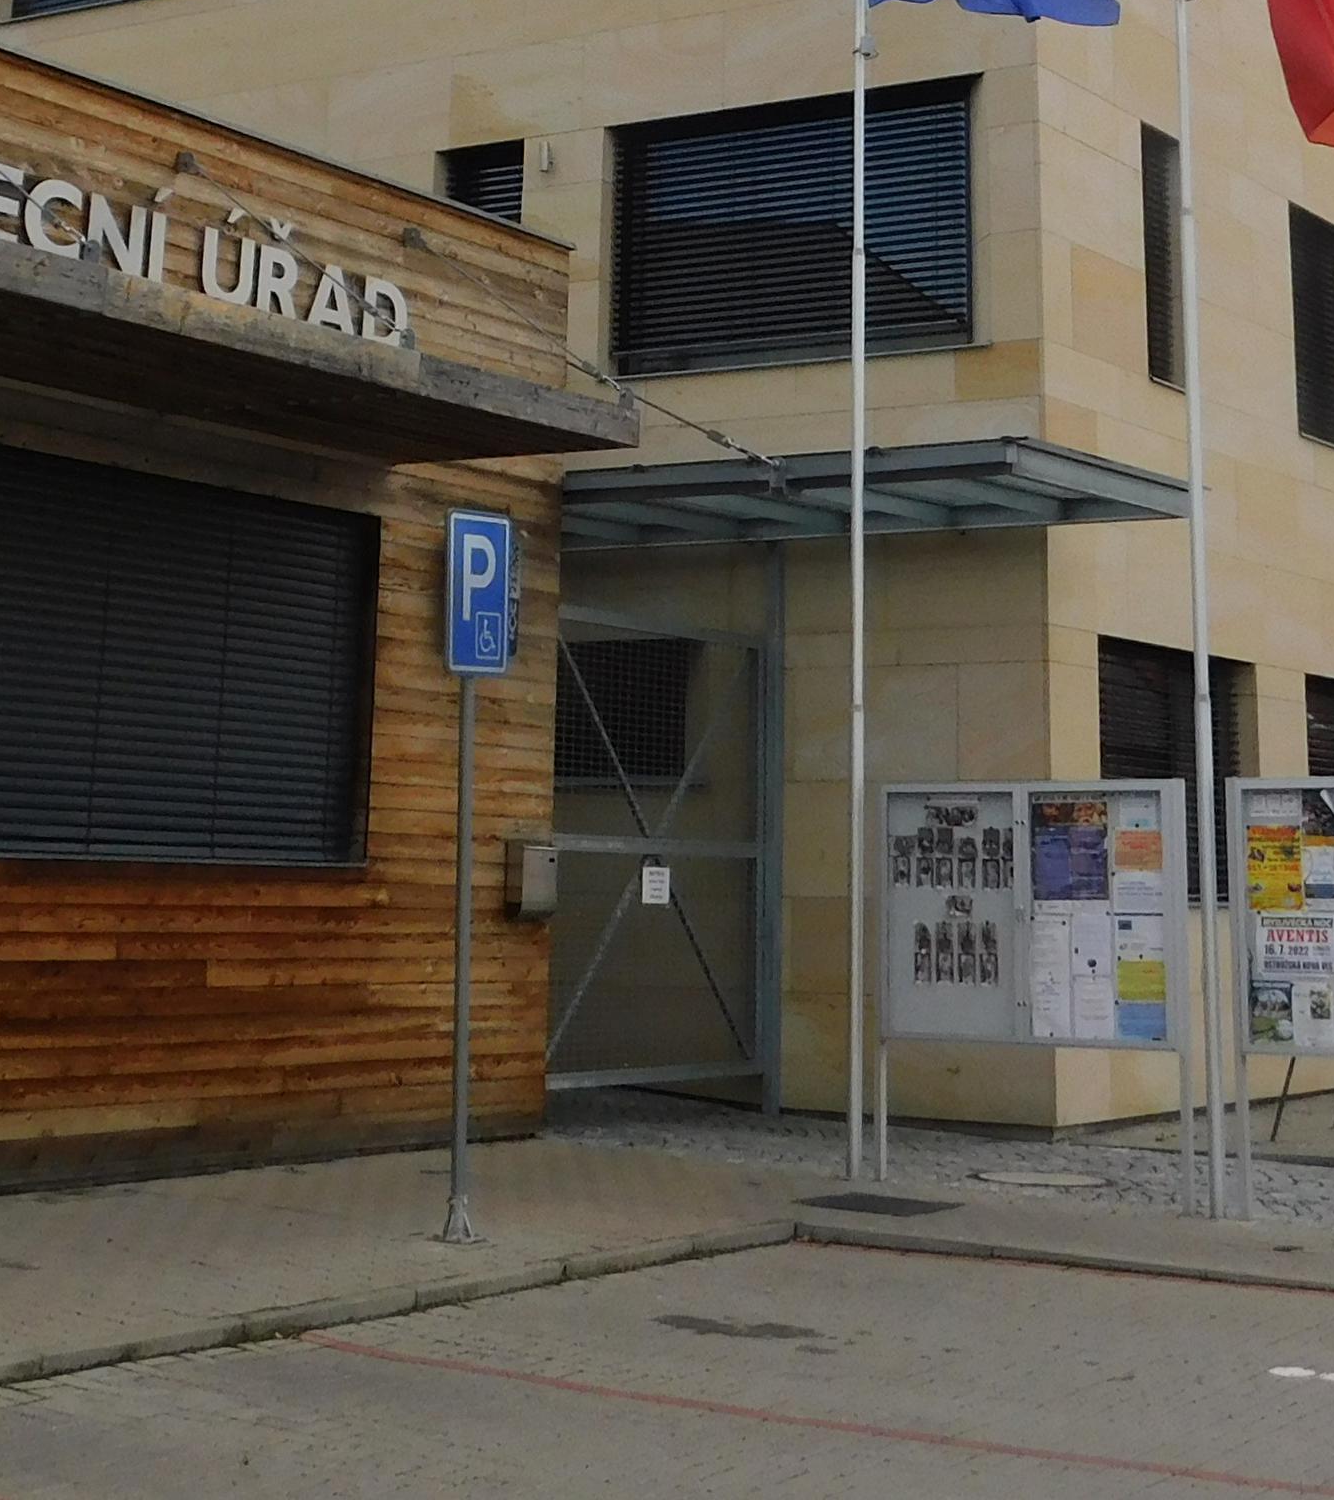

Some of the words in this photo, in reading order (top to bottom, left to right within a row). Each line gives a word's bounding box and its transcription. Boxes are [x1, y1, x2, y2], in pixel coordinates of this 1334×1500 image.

[201, 209, 408, 347] ÚŘAD
[463, 534, 496, 621] P
[1267, 929, 1329, 943] AVENTIS
